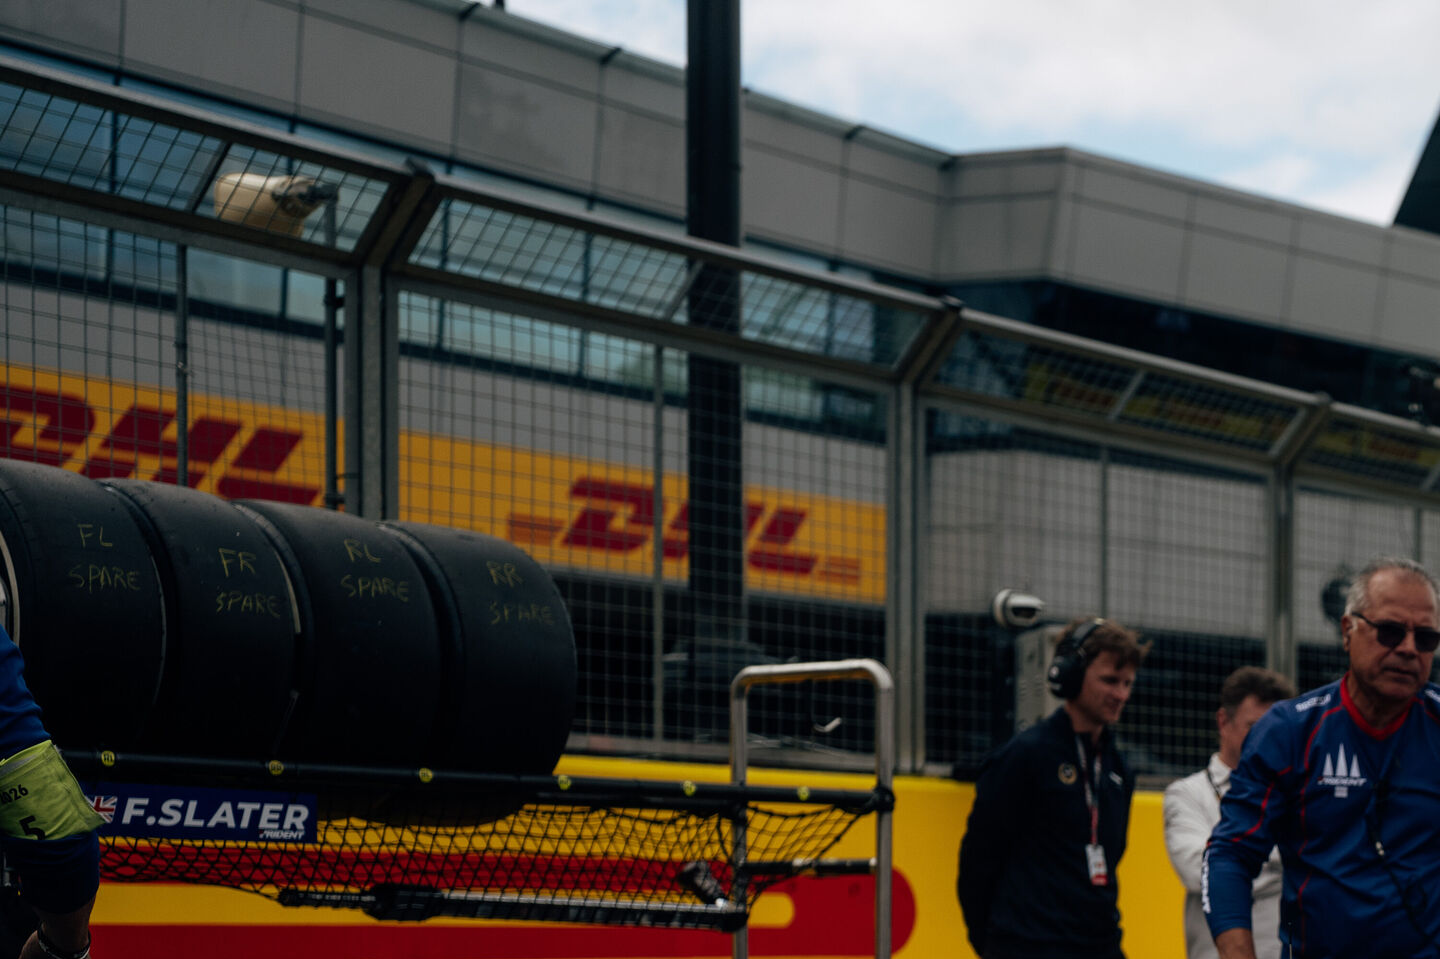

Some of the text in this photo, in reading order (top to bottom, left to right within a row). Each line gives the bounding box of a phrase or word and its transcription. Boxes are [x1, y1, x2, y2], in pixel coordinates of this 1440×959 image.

[77, 523, 113, 548] FL
[218, 548, 257, 577] FR
[343, 538, 381, 563] RL
[68, 564, 140, 593] SPARE
[486, 560, 524, 588] RR
[340, 574, 409, 602] SPARE
[215, 591, 281, 618] SPARE
[0, 783, 29, 806] 026
[121, 797, 310, 831] F.SLATER
[19, 815, 46, 841] 5
[258, 829, 305, 841] TRIDENT
